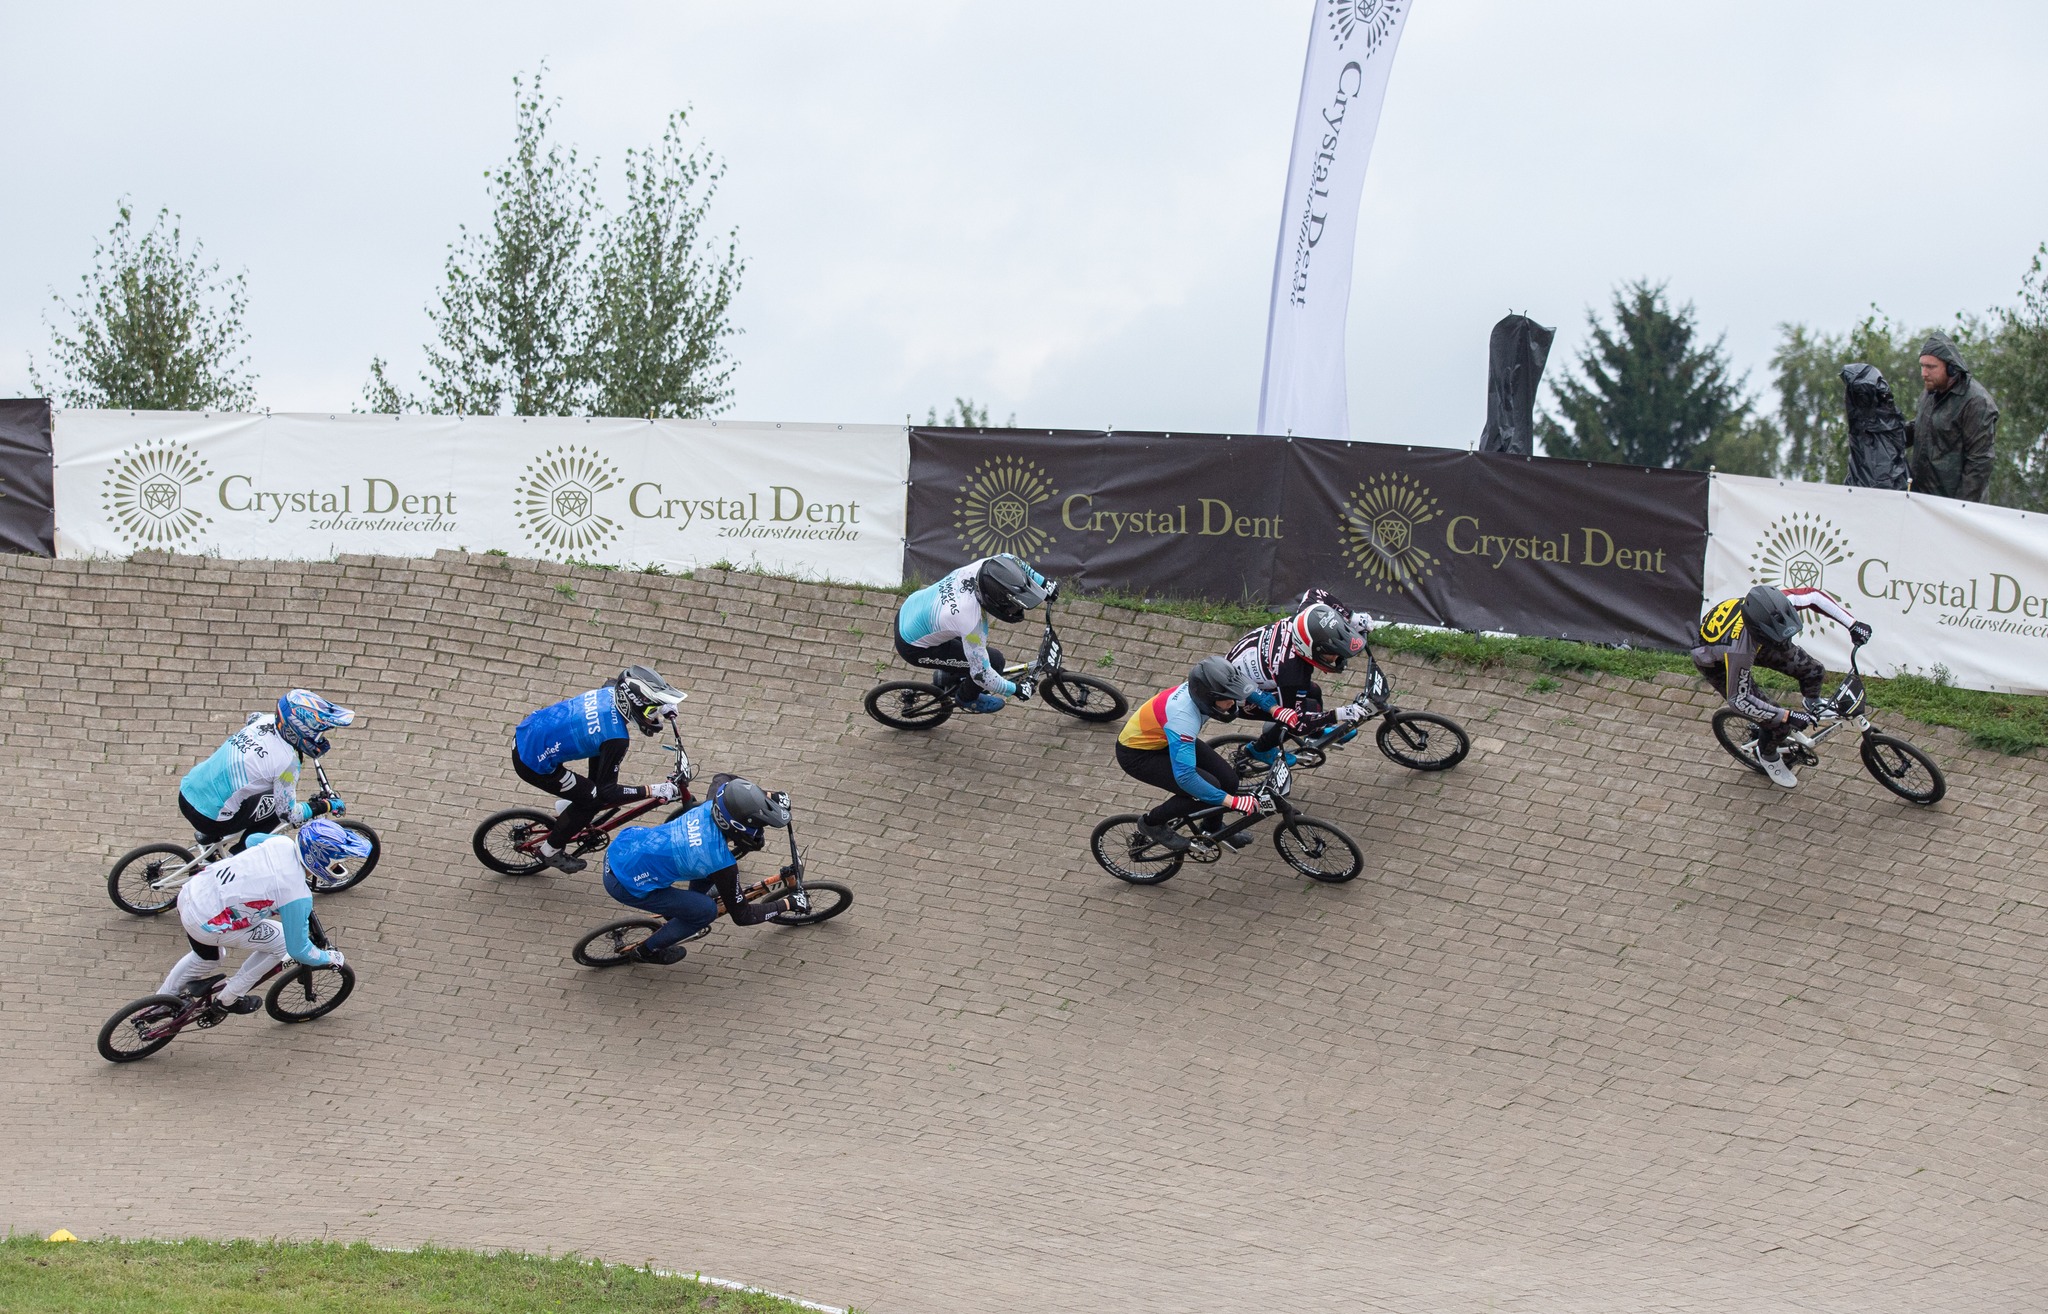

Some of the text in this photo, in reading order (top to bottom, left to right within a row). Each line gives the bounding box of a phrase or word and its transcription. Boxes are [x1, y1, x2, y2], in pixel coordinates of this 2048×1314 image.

[1295, 61, 1362, 308] Crystal Dent
[218, 474, 458, 524] Crystal Dent
[306, 510, 460, 533] zobārstniecība
[629, 482, 861, 532] Crystal Dent
[1061, 493, 1284, 545] Crystal Dent
[716, 517, 863, 542] zobārstniecība
[1446, 515, 1667, 574] Crystal Dent
[1857, 558, 1979, 615] Crystal
[1936, 606, 2048, 639] zobārstniecī
[620, 682, 644, 707] FLOW
[686, 818, 703, 848] SAAR
